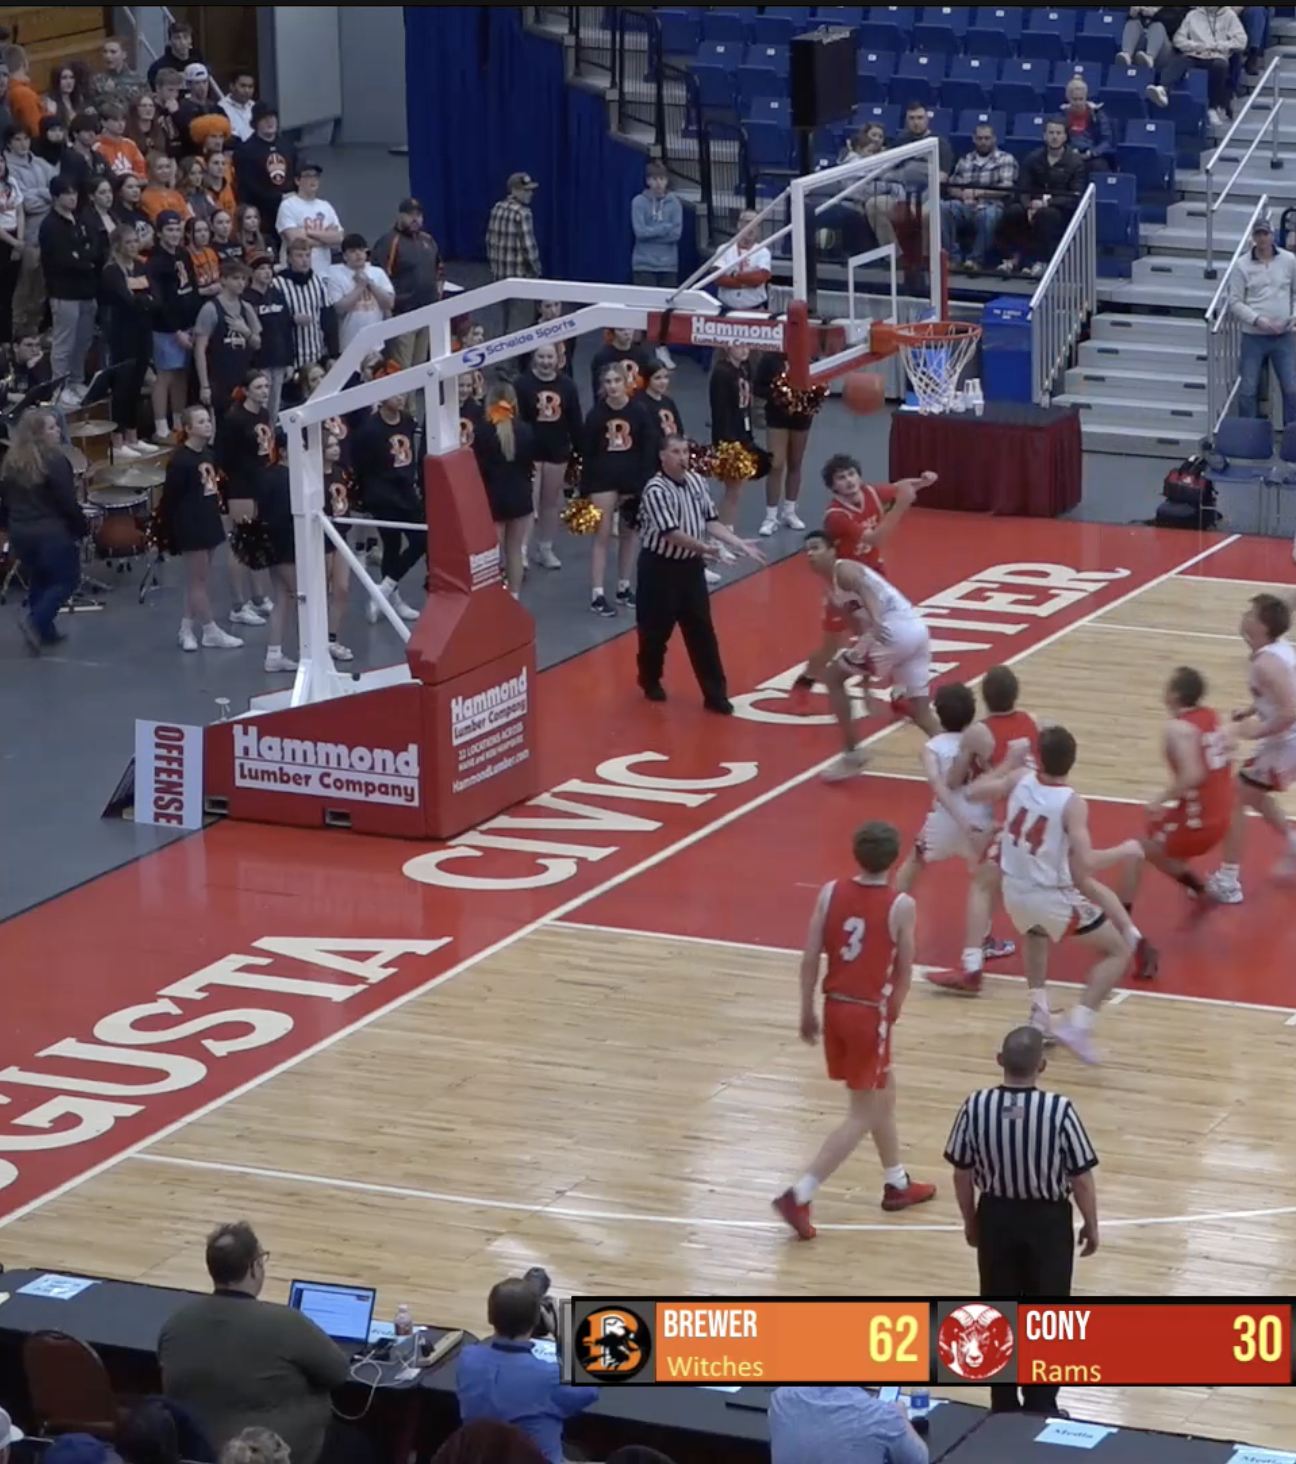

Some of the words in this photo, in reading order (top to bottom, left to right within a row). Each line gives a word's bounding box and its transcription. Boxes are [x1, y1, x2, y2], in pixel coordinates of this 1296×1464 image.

[535, 319, 576, 338] Sports
[691, 316, 783, 339] Hammond
[537, 390, 562, 422] B
[606, 418, 633, 452] B
[729, 562, 1131, 725] CETER
[451, 666, 527, 723] Hammond
[455, 719, 486, 739] Lumber
[488, 700, 527, 723] Company
[233, 724, 419, 777] Hammond
[452, 749, 529, 793] HammondLumber.com
[154, 725, 185, 826] OFFENSE
[240, 763, 312, 787] Lumber
[319, 772, 416, 803] Company
[402, 751, 759, 890] CIVIC
[1008, 807, 1049, 855] 44
[842, 916, 865, 962] 3
[0, 936, 453, 1192] GUSTA
[1053, 1427, 1094, 1440] Media
